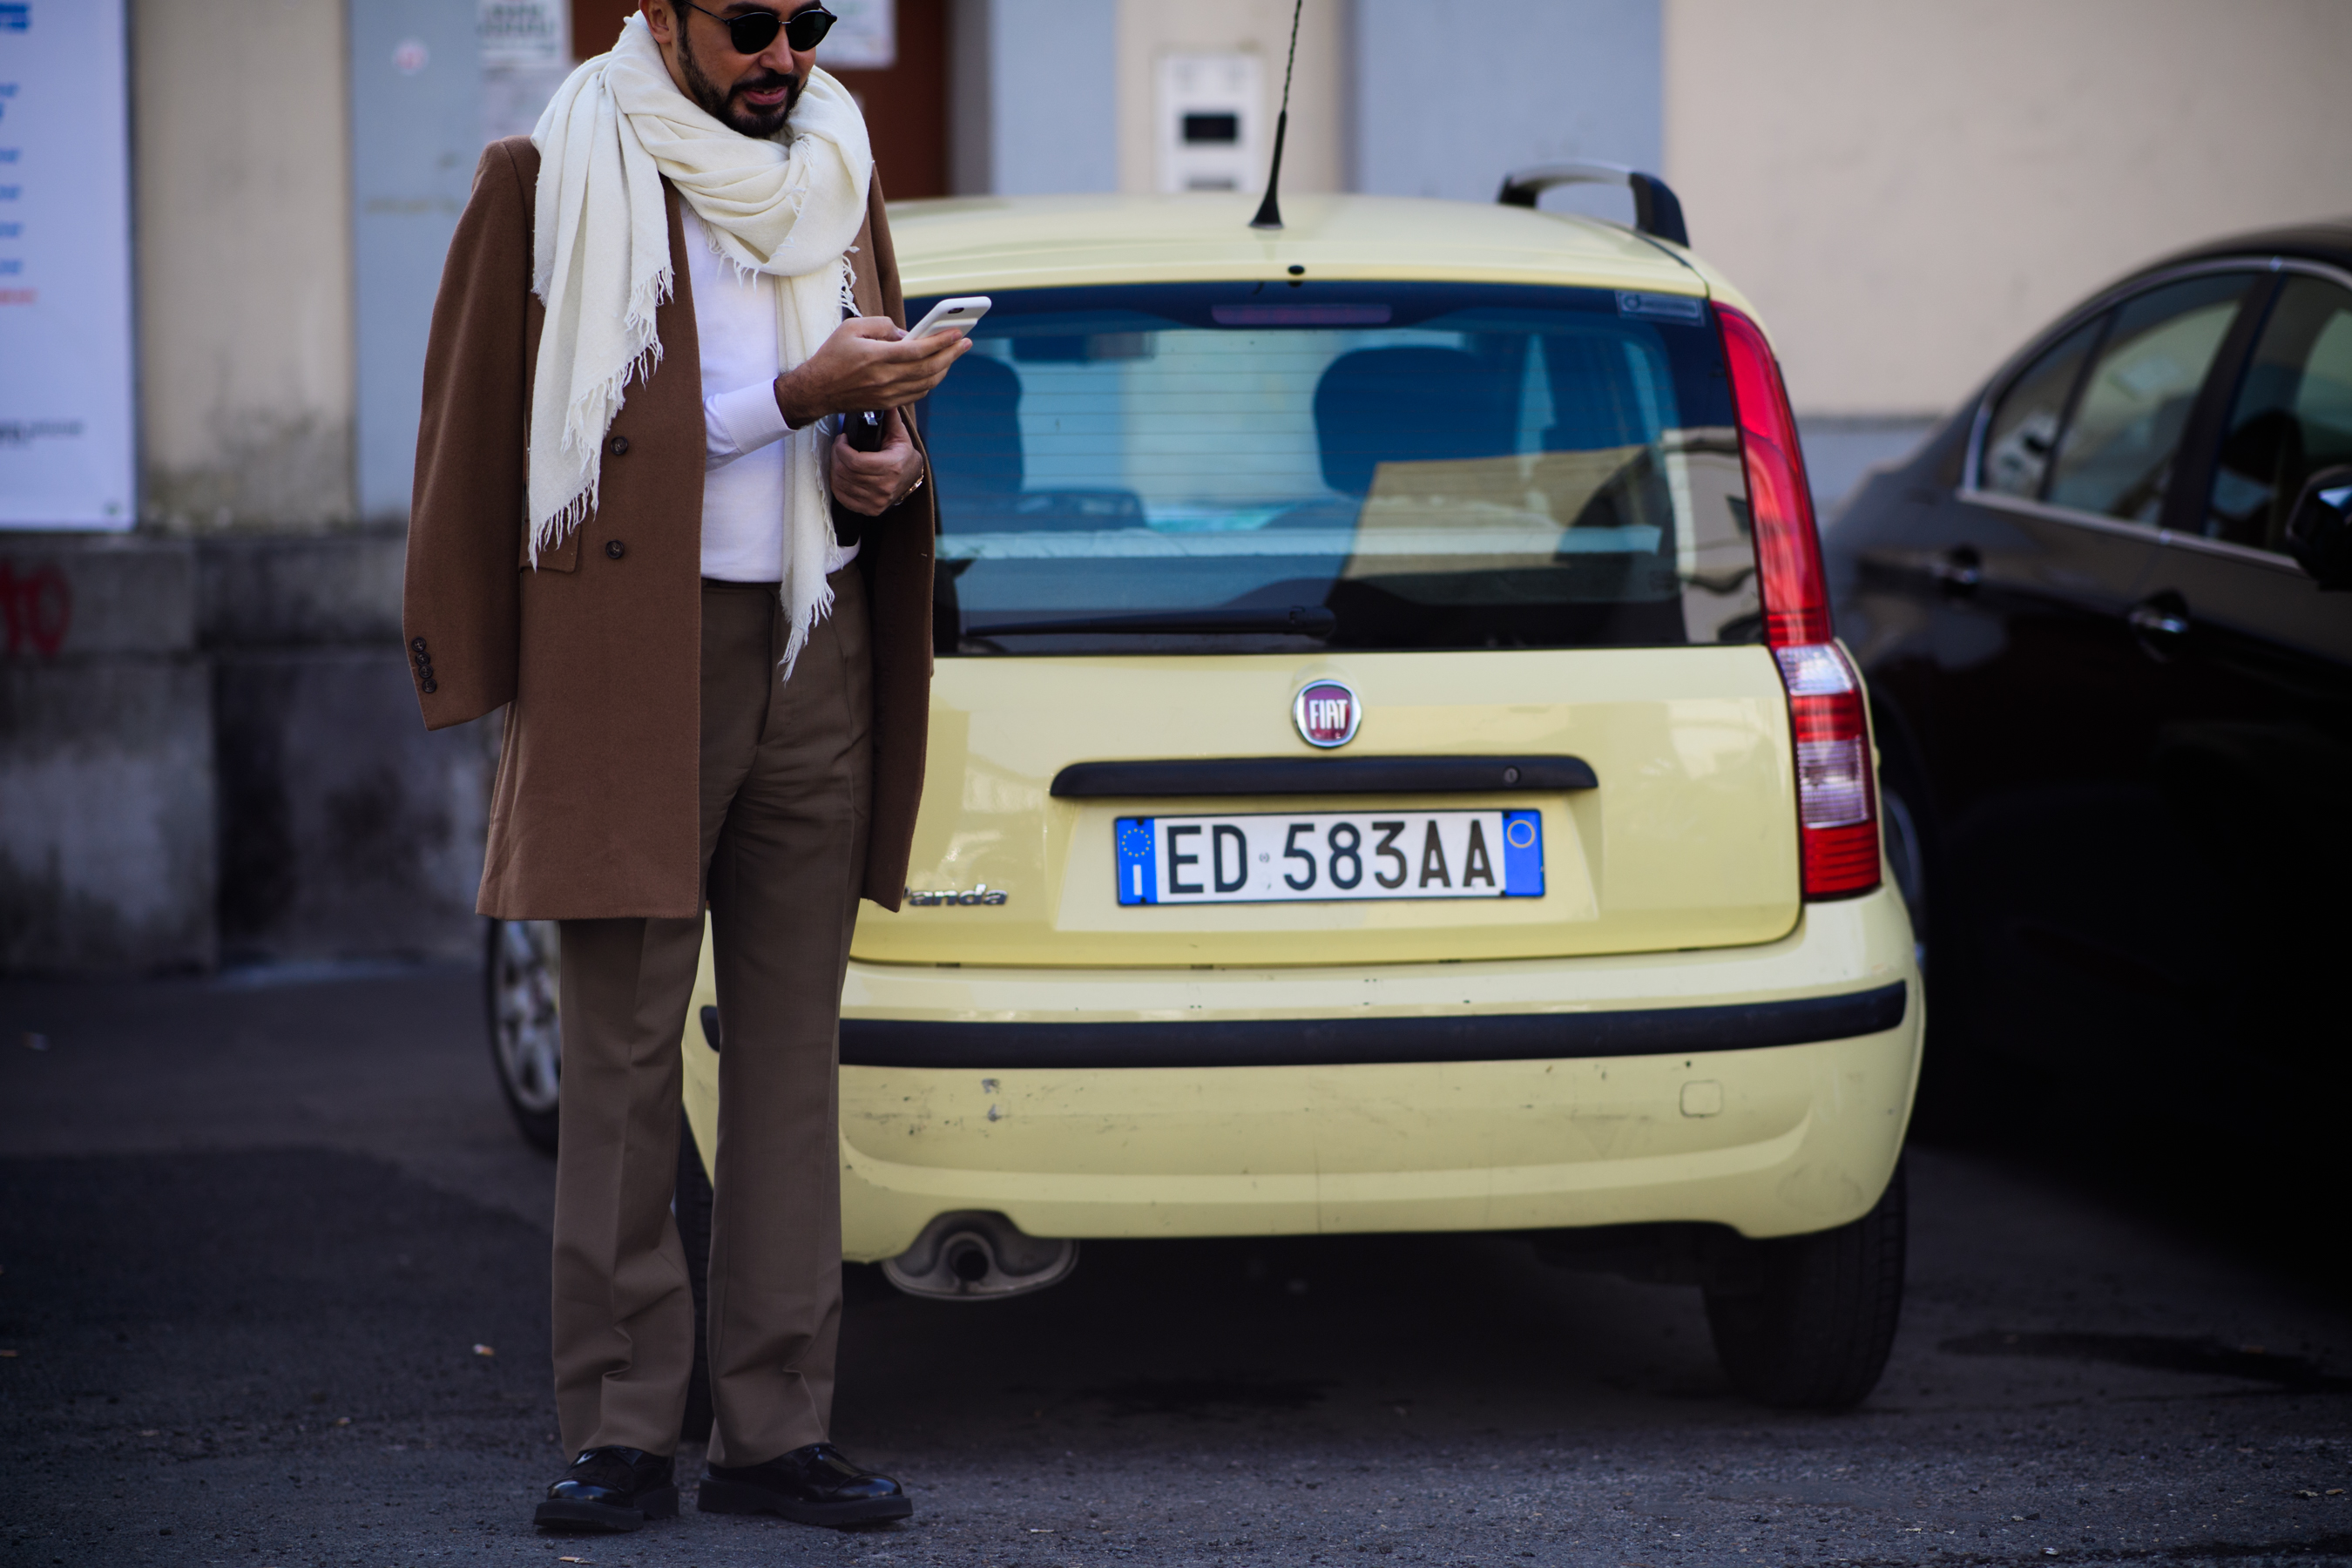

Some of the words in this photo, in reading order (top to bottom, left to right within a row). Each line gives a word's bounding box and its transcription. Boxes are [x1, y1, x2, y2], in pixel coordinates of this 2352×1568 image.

[1309, 699, 1348, 730] FIAT
[1167, 824, 1248, 894] ED
[1283, 820, 1496, 891] 583AA
